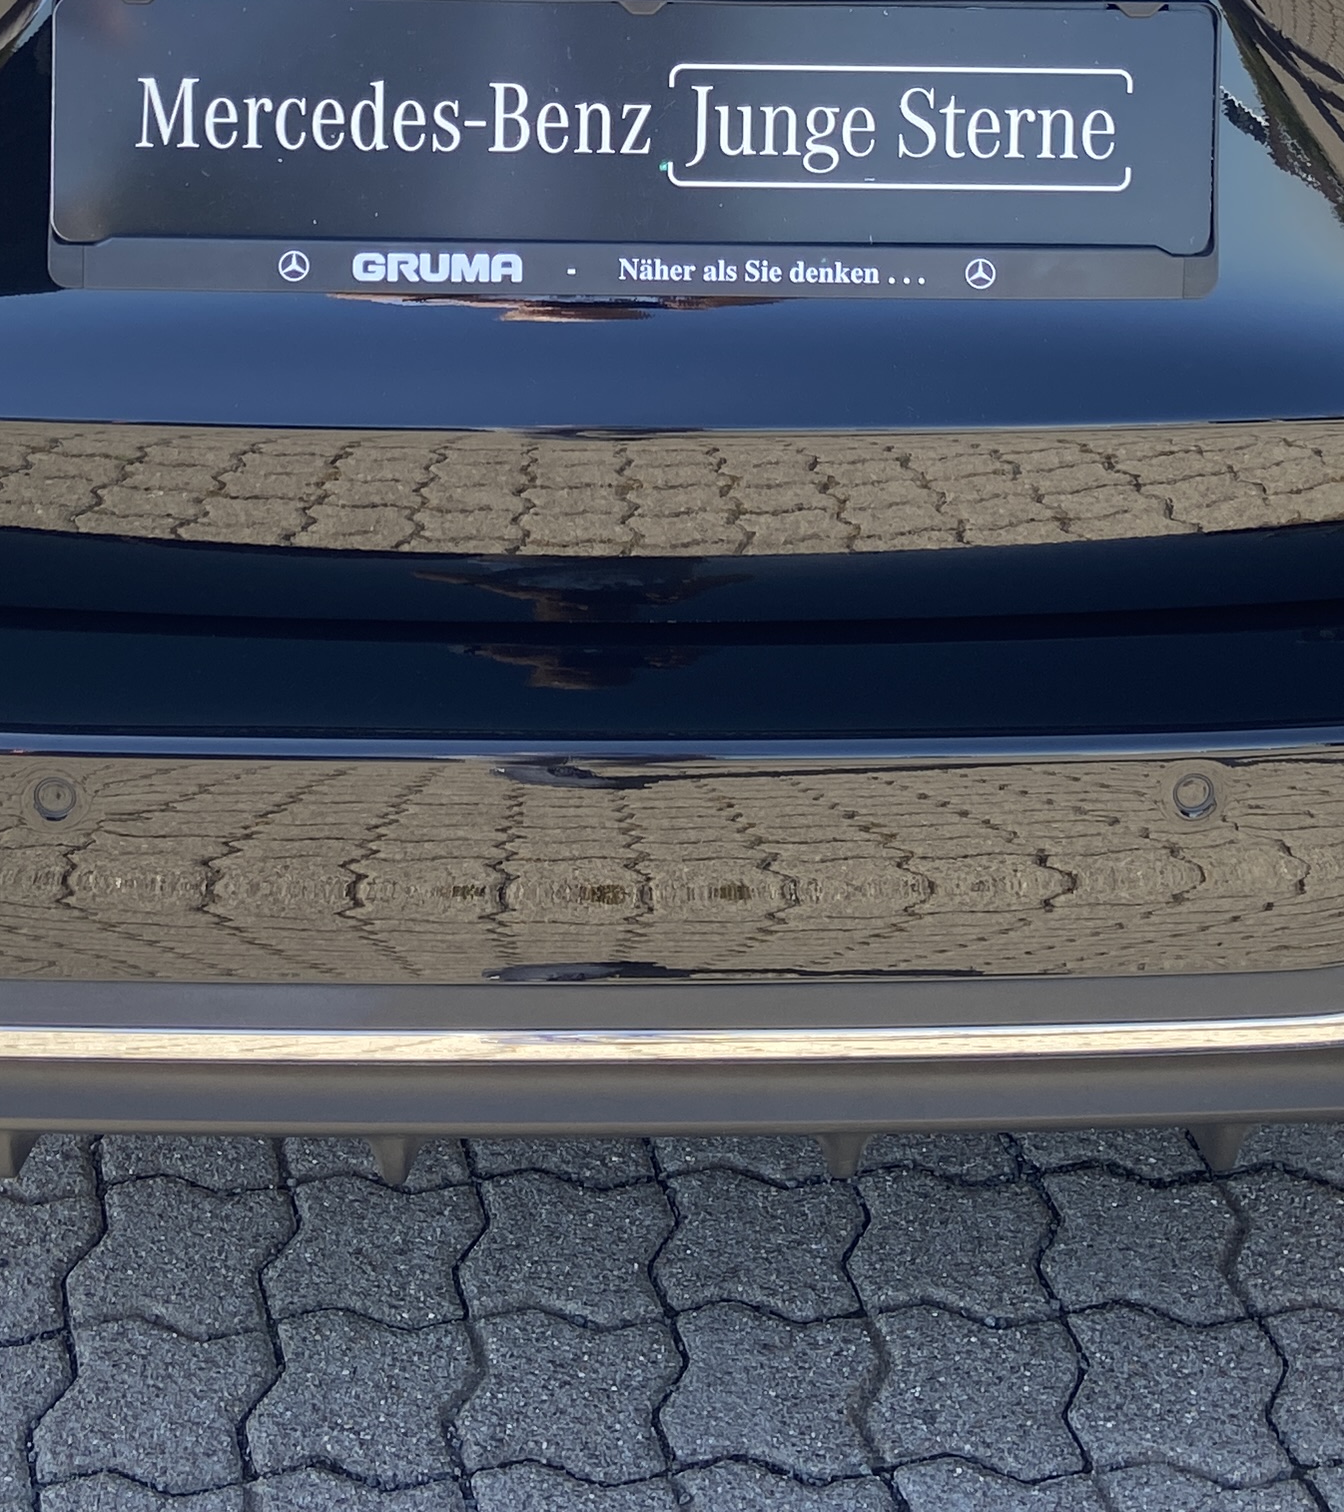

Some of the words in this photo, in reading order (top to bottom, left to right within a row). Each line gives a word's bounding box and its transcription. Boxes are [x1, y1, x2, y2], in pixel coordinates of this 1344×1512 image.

[134, 76, 653, 155] Mercedes-Benz
[684, 84, 877, 174] Junge
[897, 86, 1116, 161] Sterne
[351, 251, 524, 283] GRUMA
[618, 257, 697, 282] Näher
[702, 259, 739, 283] als
[744, 259, 780, 284] Sie
[788, 260, 881, 285] denken
